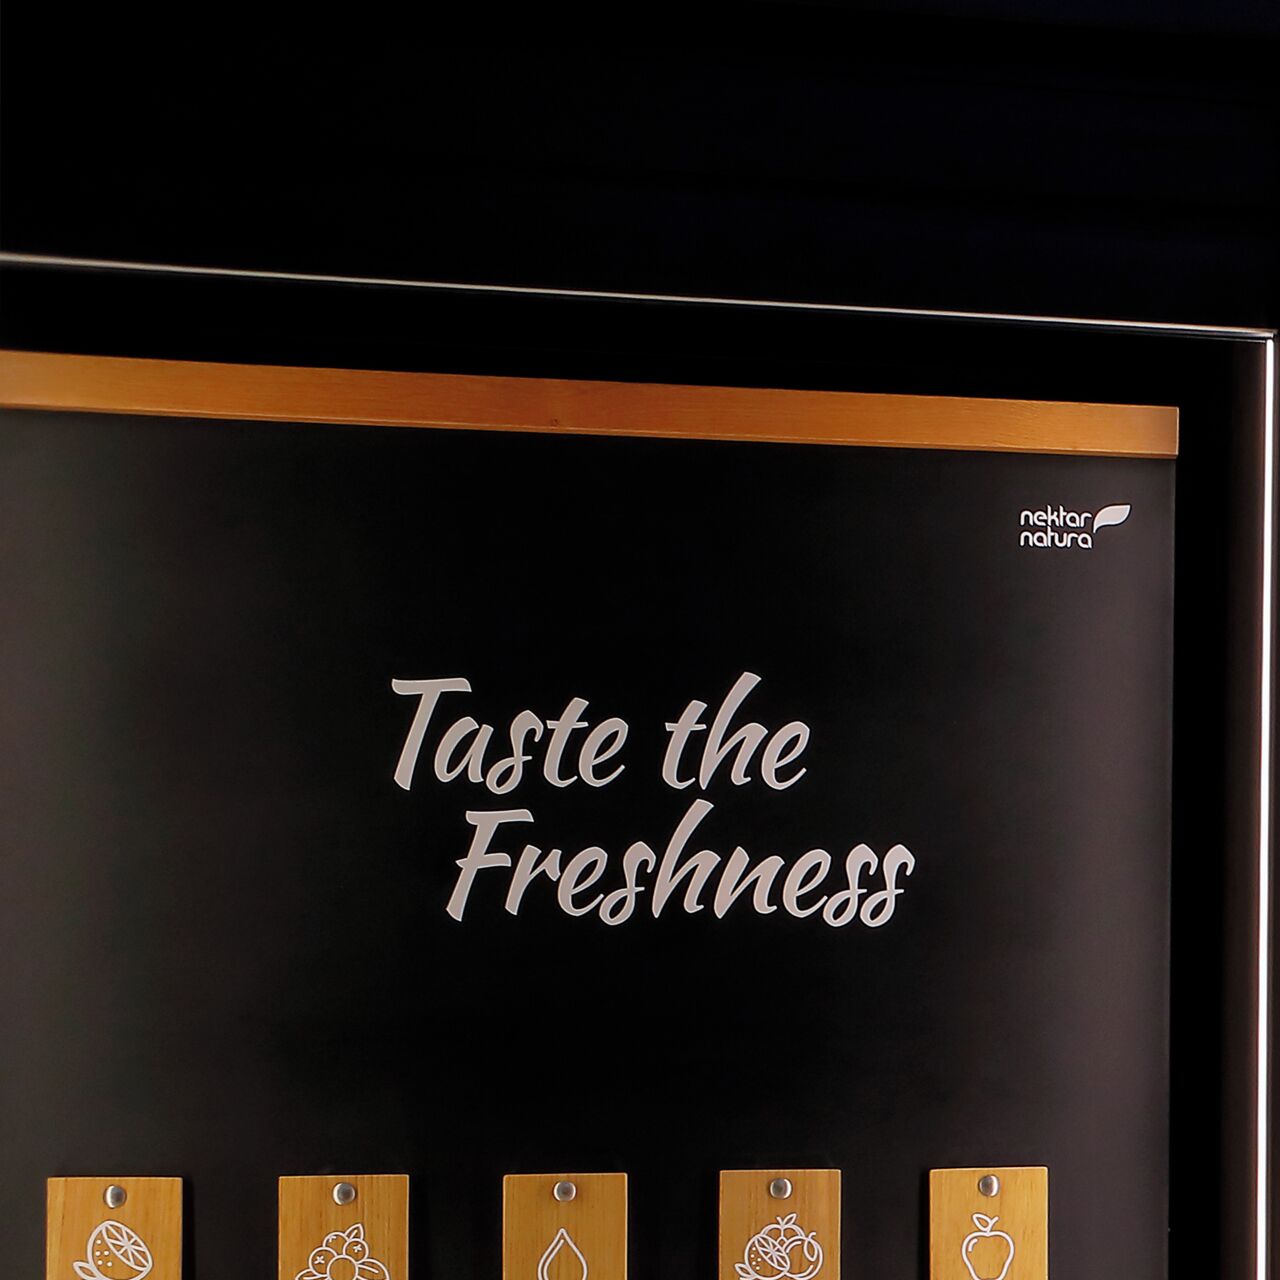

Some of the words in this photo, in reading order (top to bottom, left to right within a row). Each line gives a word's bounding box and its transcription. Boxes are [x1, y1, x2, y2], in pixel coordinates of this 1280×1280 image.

[1020, 504, 1093, 528] nektar
[1020, 526, 1093, 549] natura
[391, 677, 629, 795] Taste
[661, 671, 811, 791] the
[446, 798, 916, 928] Freshness
